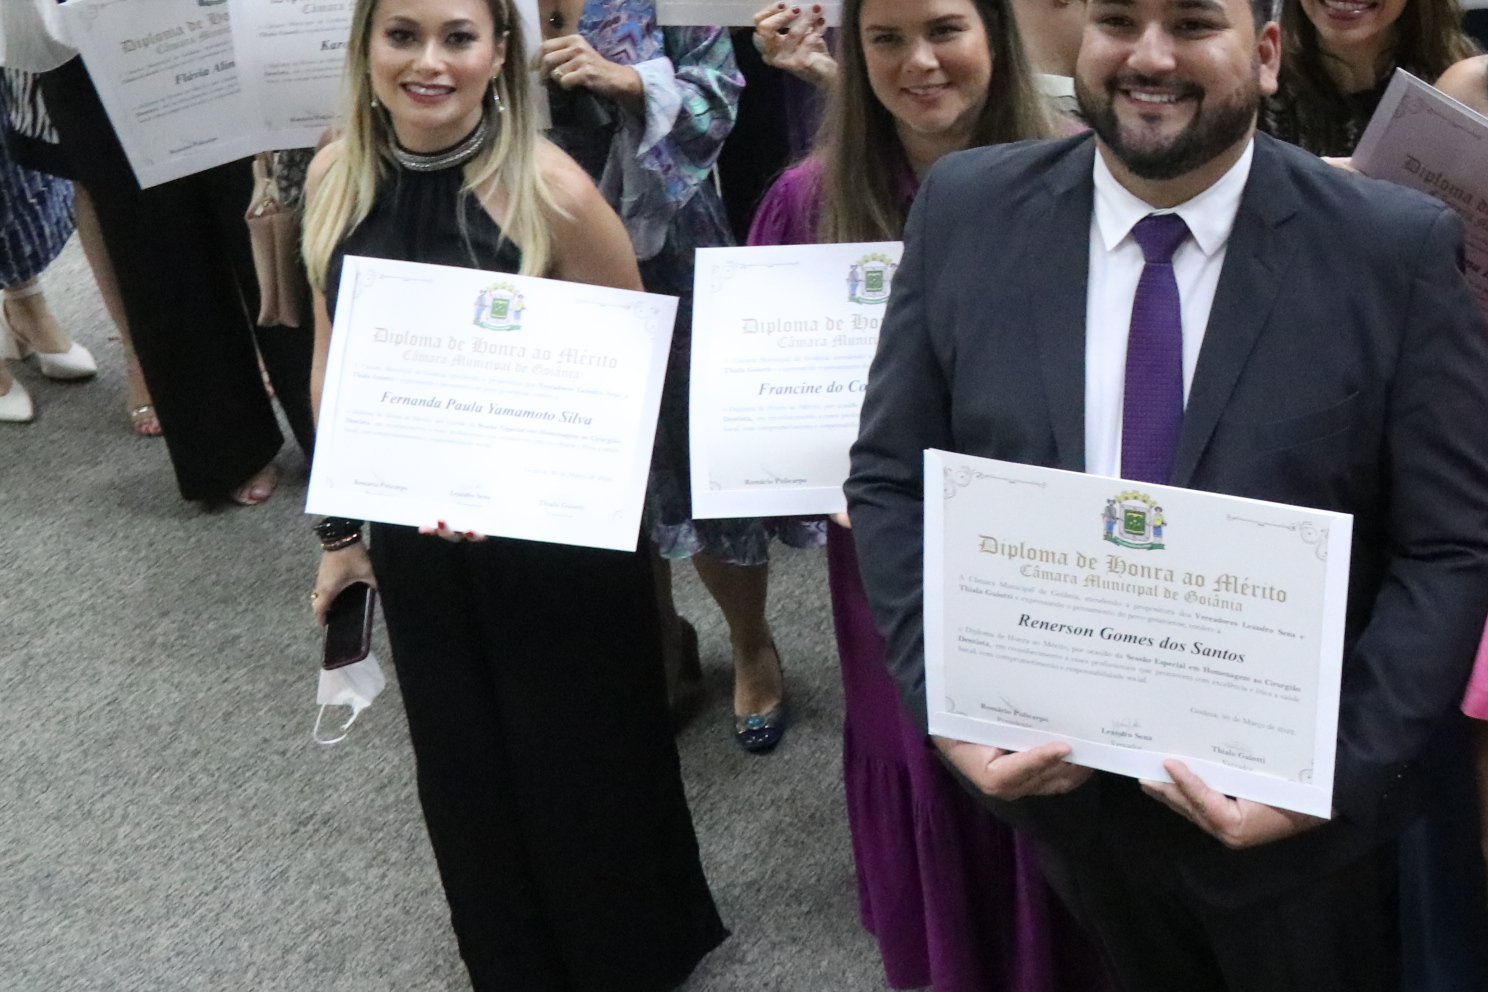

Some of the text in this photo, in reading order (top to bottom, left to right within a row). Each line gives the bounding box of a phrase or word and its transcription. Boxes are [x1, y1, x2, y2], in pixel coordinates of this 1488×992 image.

[121, 27, 184, 53] Diploma
[174, 68, 210, 86] Flávia
[1402, 154, 1474, 204] Diploma
[741, 318, 818, 335] Diploma
[825, 317, 843, 331] de
[373, 327, 618, 370] Diploma de Honra ao Mérito
[402, 349, 447, 366] Câmara
[451, 352, 512, 373] Municipal
[516, 361, 528, 371] de
[758, 382, 822, 395] Francine
[827, 380, 843, 393] do
[380, 390, 593, 426] Fernanda Paula Yamamoto Silva
[978, 535, 1287, 603] Diploma de Honra ao Mérito
[1020, 564, 1243, 612] Câmara Municipal de Goiânia
[1018, 613, 1245, 664] Renerson Gomes dos Santos
